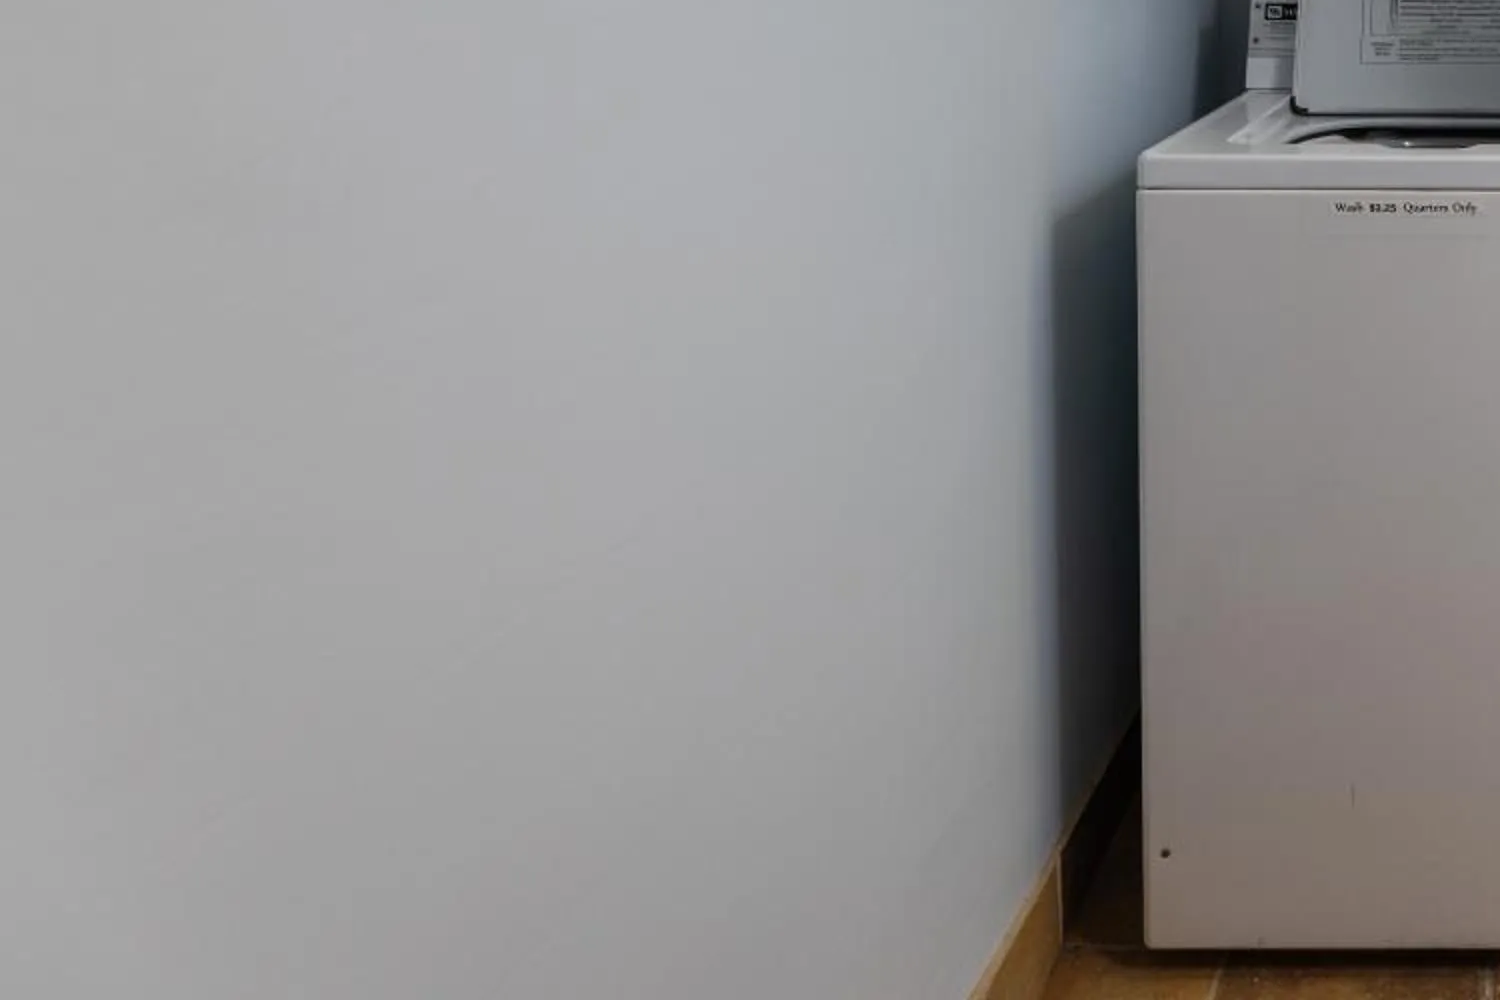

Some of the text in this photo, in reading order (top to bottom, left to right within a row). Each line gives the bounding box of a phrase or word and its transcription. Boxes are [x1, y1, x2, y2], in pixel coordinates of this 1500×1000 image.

[1335, 202, 1364, 213] Wash
[1403, 201, 1449, 215] Quarters
[1451, 201, 1478, 216] Only
